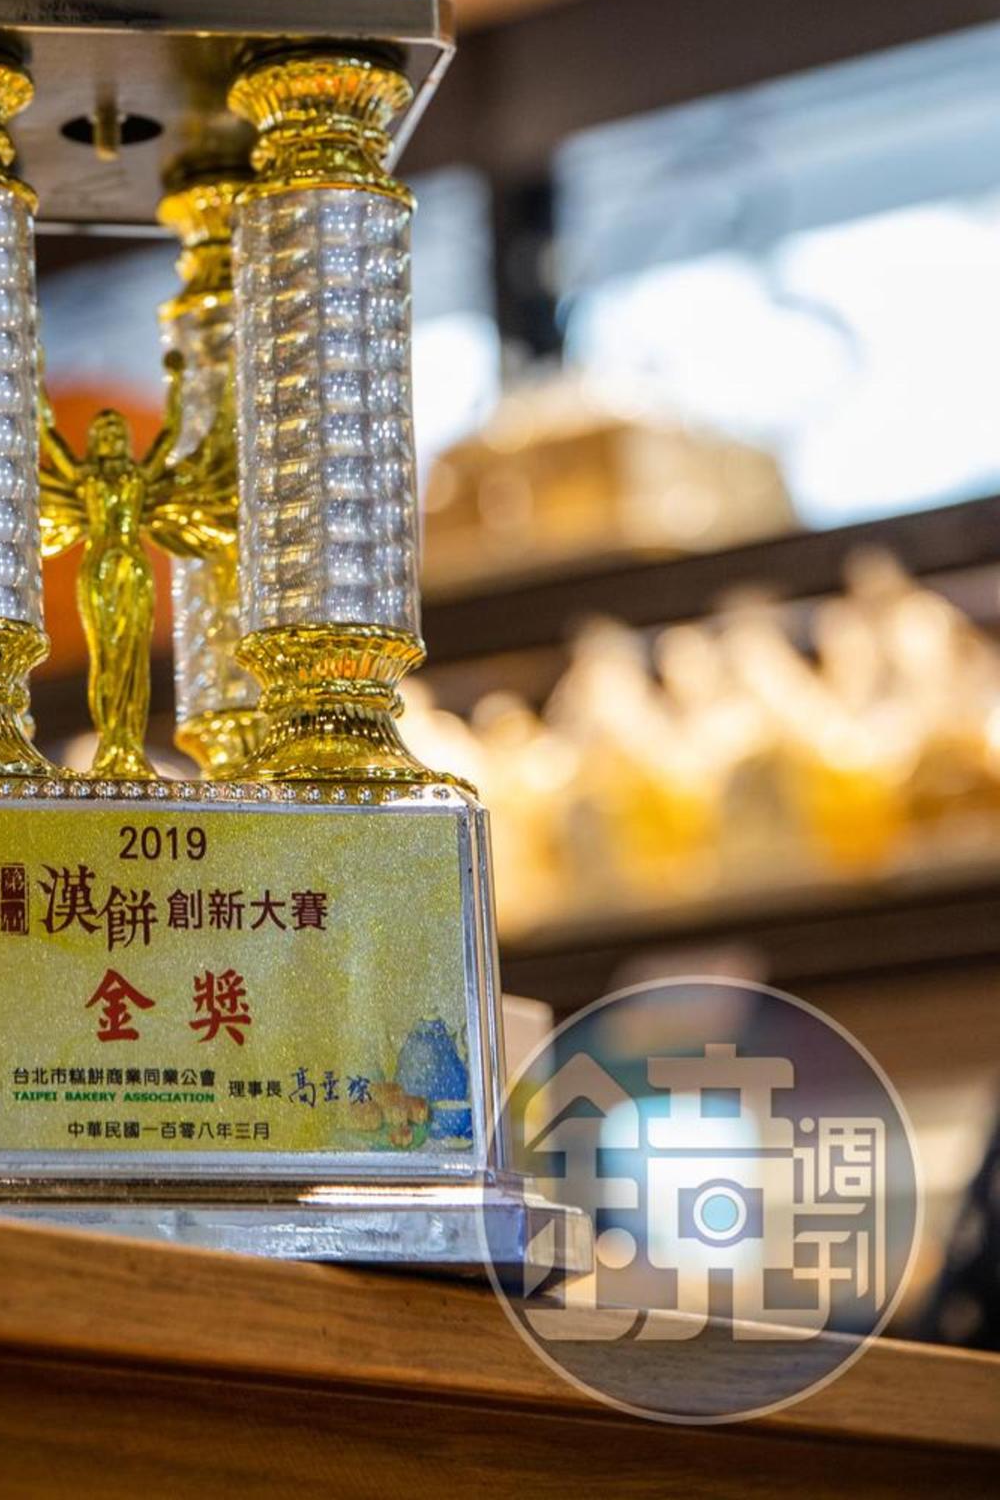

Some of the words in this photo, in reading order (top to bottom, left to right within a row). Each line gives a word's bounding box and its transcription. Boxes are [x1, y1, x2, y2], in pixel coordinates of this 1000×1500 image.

[119, 826, 207, 861] 2019
[37, 864, 328, 952] 漢餅創新大賽
[85, 968, 252, 1046] 金獎
[13, 1067, 216, 1087] 台北市糕餅商業同業公會
[229, 1080, 282, 1098] 理事長
[13, 1091, 58, 1103] TAIPEI
[65, 1091, 116, 1103] BAKERY
[123, 1091, 216, 1104] ASSOCIATION
[67, 1121, 270, 1141] 中華民國一百零八年三月
